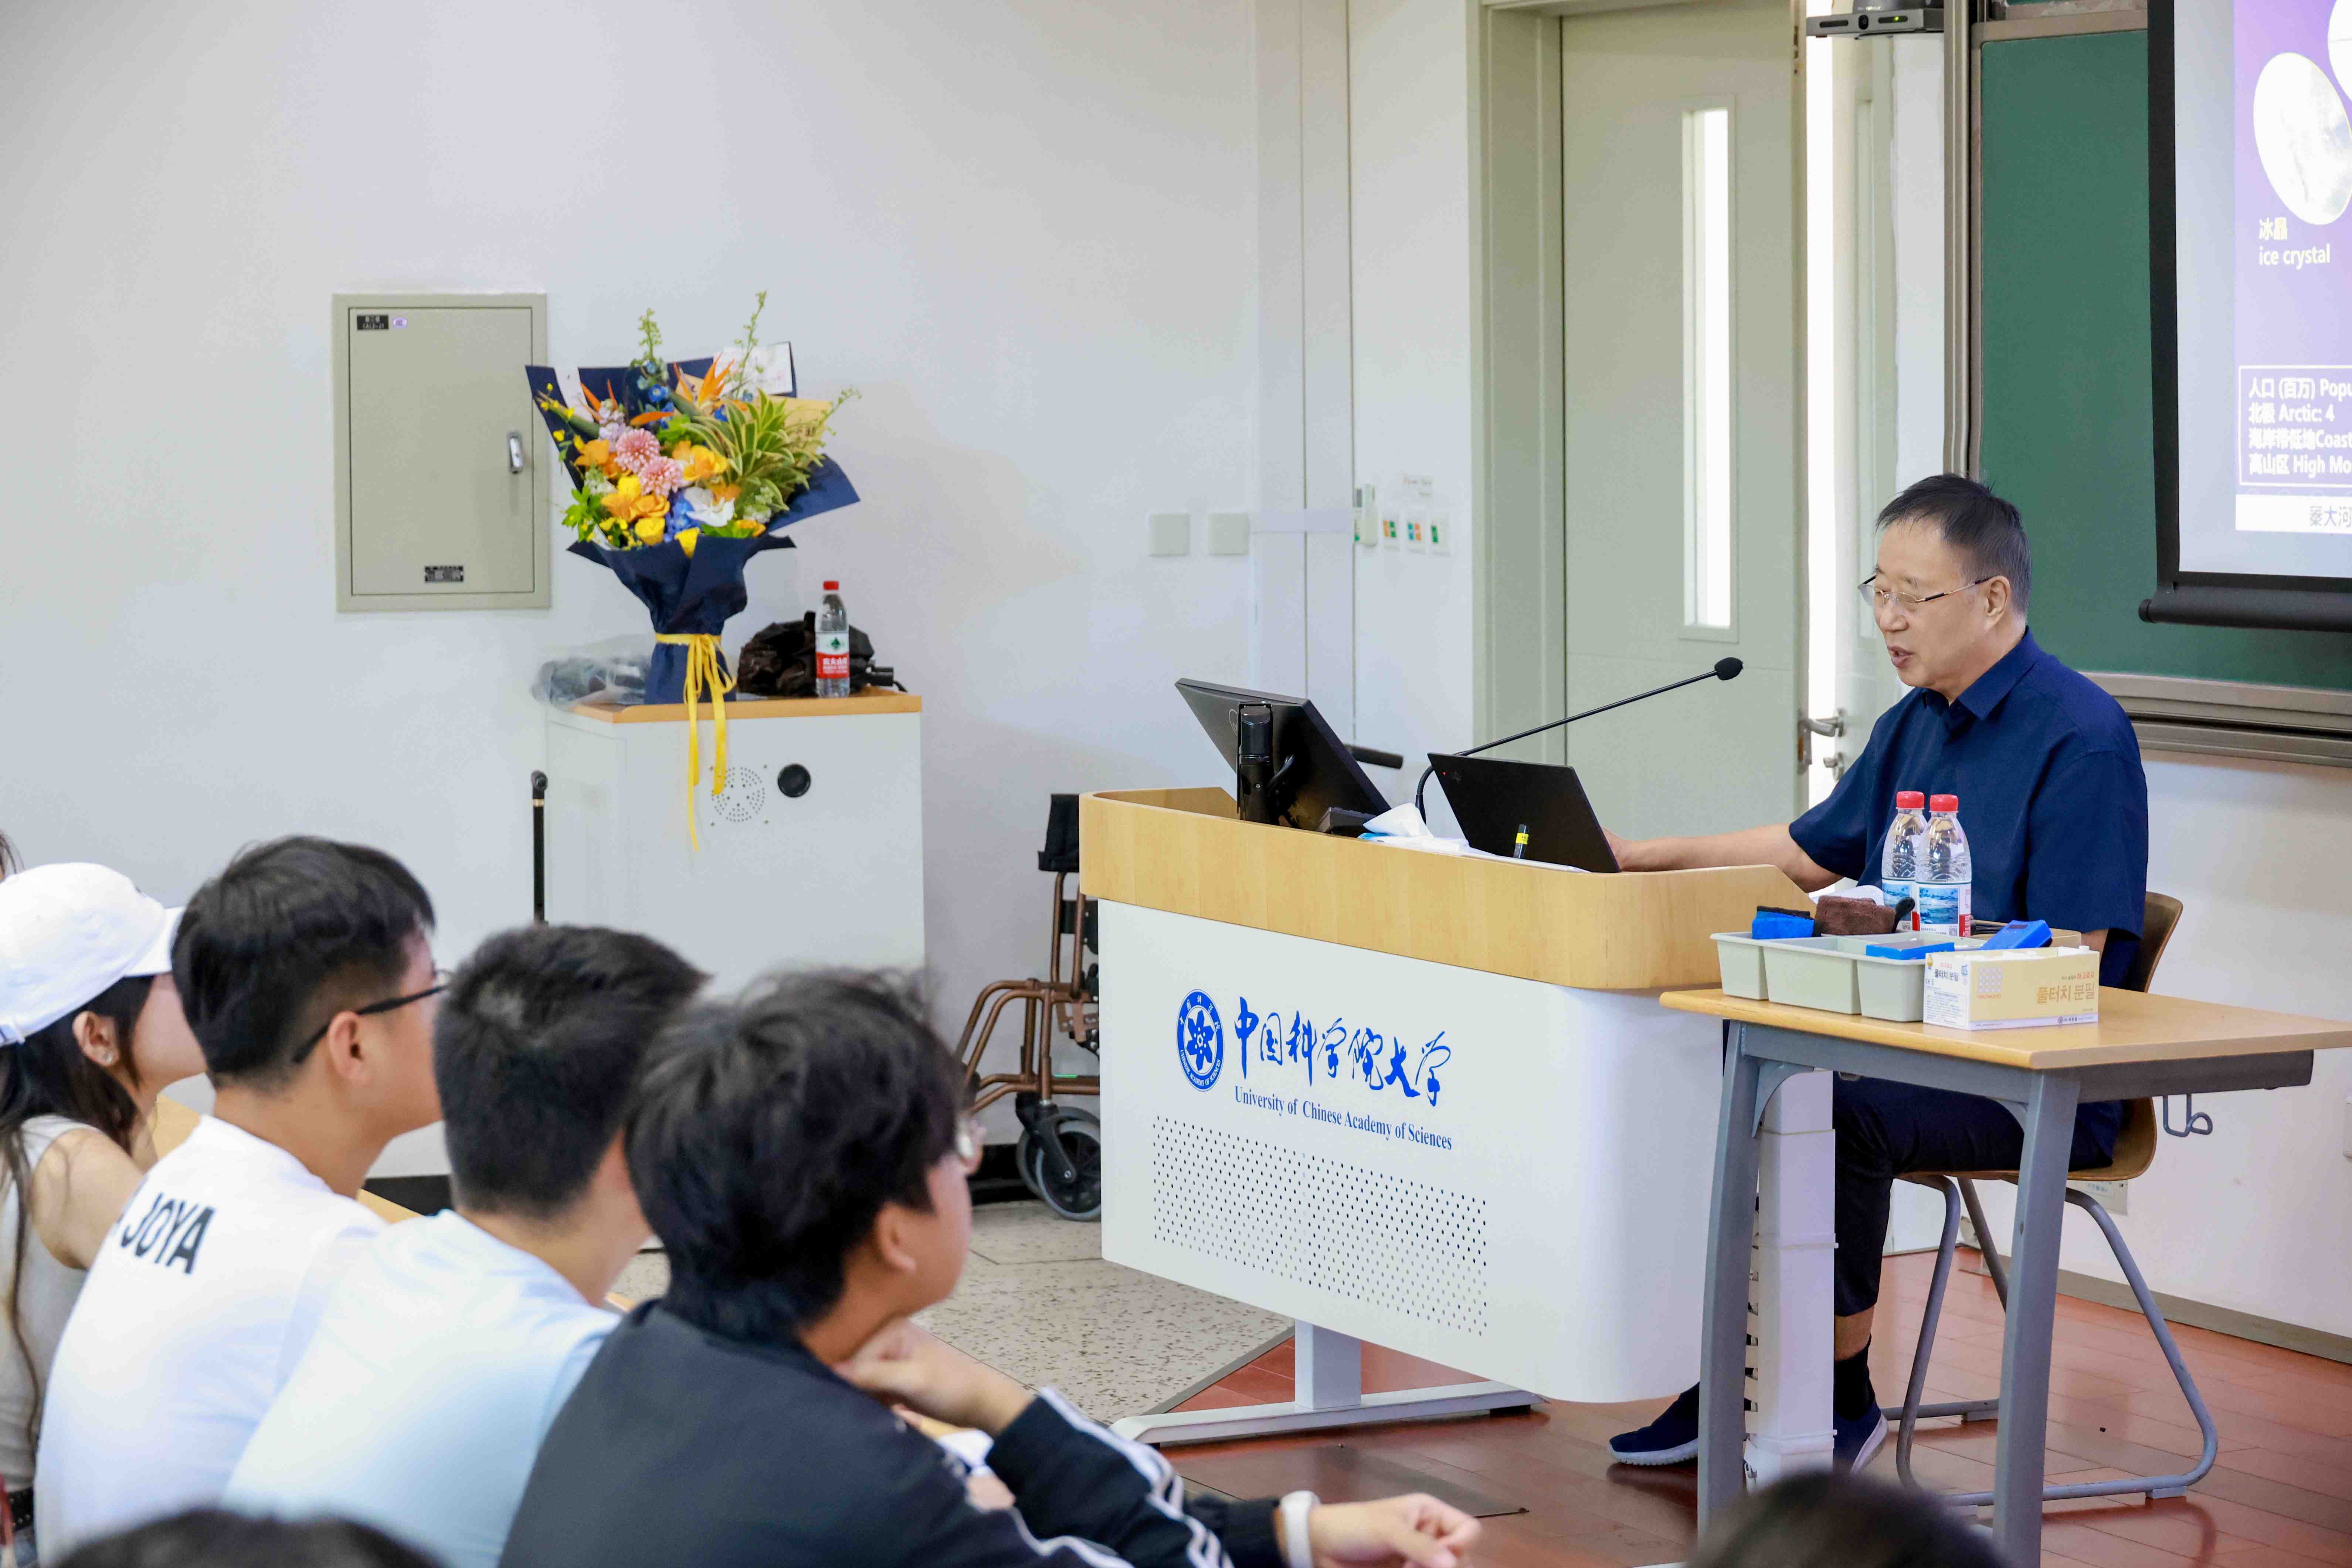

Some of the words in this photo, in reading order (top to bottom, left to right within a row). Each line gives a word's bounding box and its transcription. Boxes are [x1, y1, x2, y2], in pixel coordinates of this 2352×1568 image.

[2259, 217, 2288, 240] 冰晶
[2259, 245, 2279, 265] ice
[2283, 243, 2330, 270] crystal
[2249, 377, 2274, 398] 人口
[2279, 377, 2315, 400] (百万)
[2248, 402, 2275, 424] 北极
[2279, 404, 2322, 422] Arctic:
[2325, 404, 2335, 422] 4
[2293, 454, 2325, 478] High
[2037, 985, 2071, 1004] 풀터치
[2074, 982, 2094, 1001] 분필
[1234, 996, 1452, 1107] 中国科学院大学
[1235, 1085, 1284, 1116] University
[1287, 1099, 1298, 1114] of
[1303, 1100, 1343, 1125] Chinese
[1345, 1111, 1391, 1140] Academy
[1395, 1122, 1406, 1139] of
[1408, 1123, 1453, 1151] Sciences
[121, 1192, 215, 1274] JOYA
